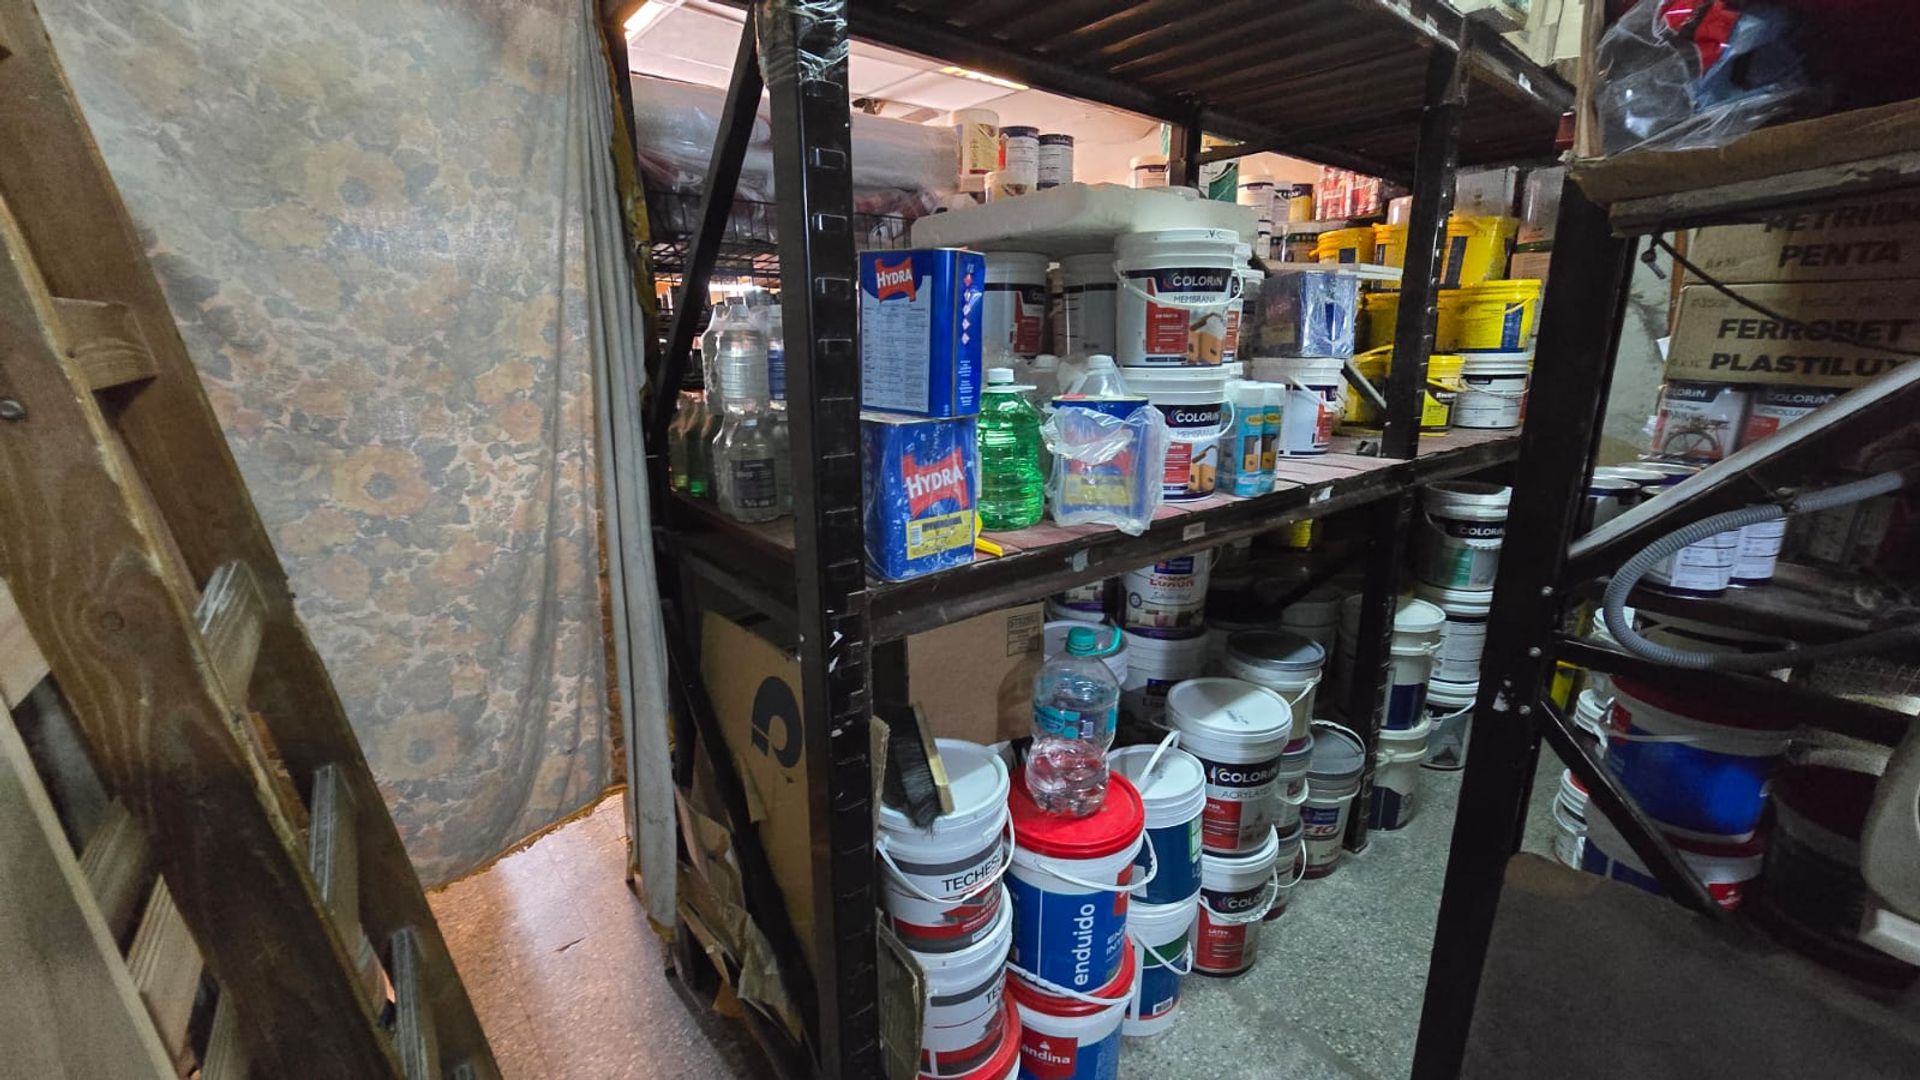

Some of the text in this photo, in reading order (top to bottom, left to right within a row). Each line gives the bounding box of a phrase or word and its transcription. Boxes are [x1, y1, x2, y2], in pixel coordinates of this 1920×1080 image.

[1779, 241, 1899, 267] PENTA
[876, 269, 914, 288] HYDRA
[1172, 275, 1223, 287] COLORIN
[1717, 318, 1909, 342] FERROBET
[1176, 411, 1219, 423] COLORIN
[906, 464, 964, 499] HYDRA
[1072, 904, 1096, 986] enduido
[1022, 1044, 1071, 1064] andina
